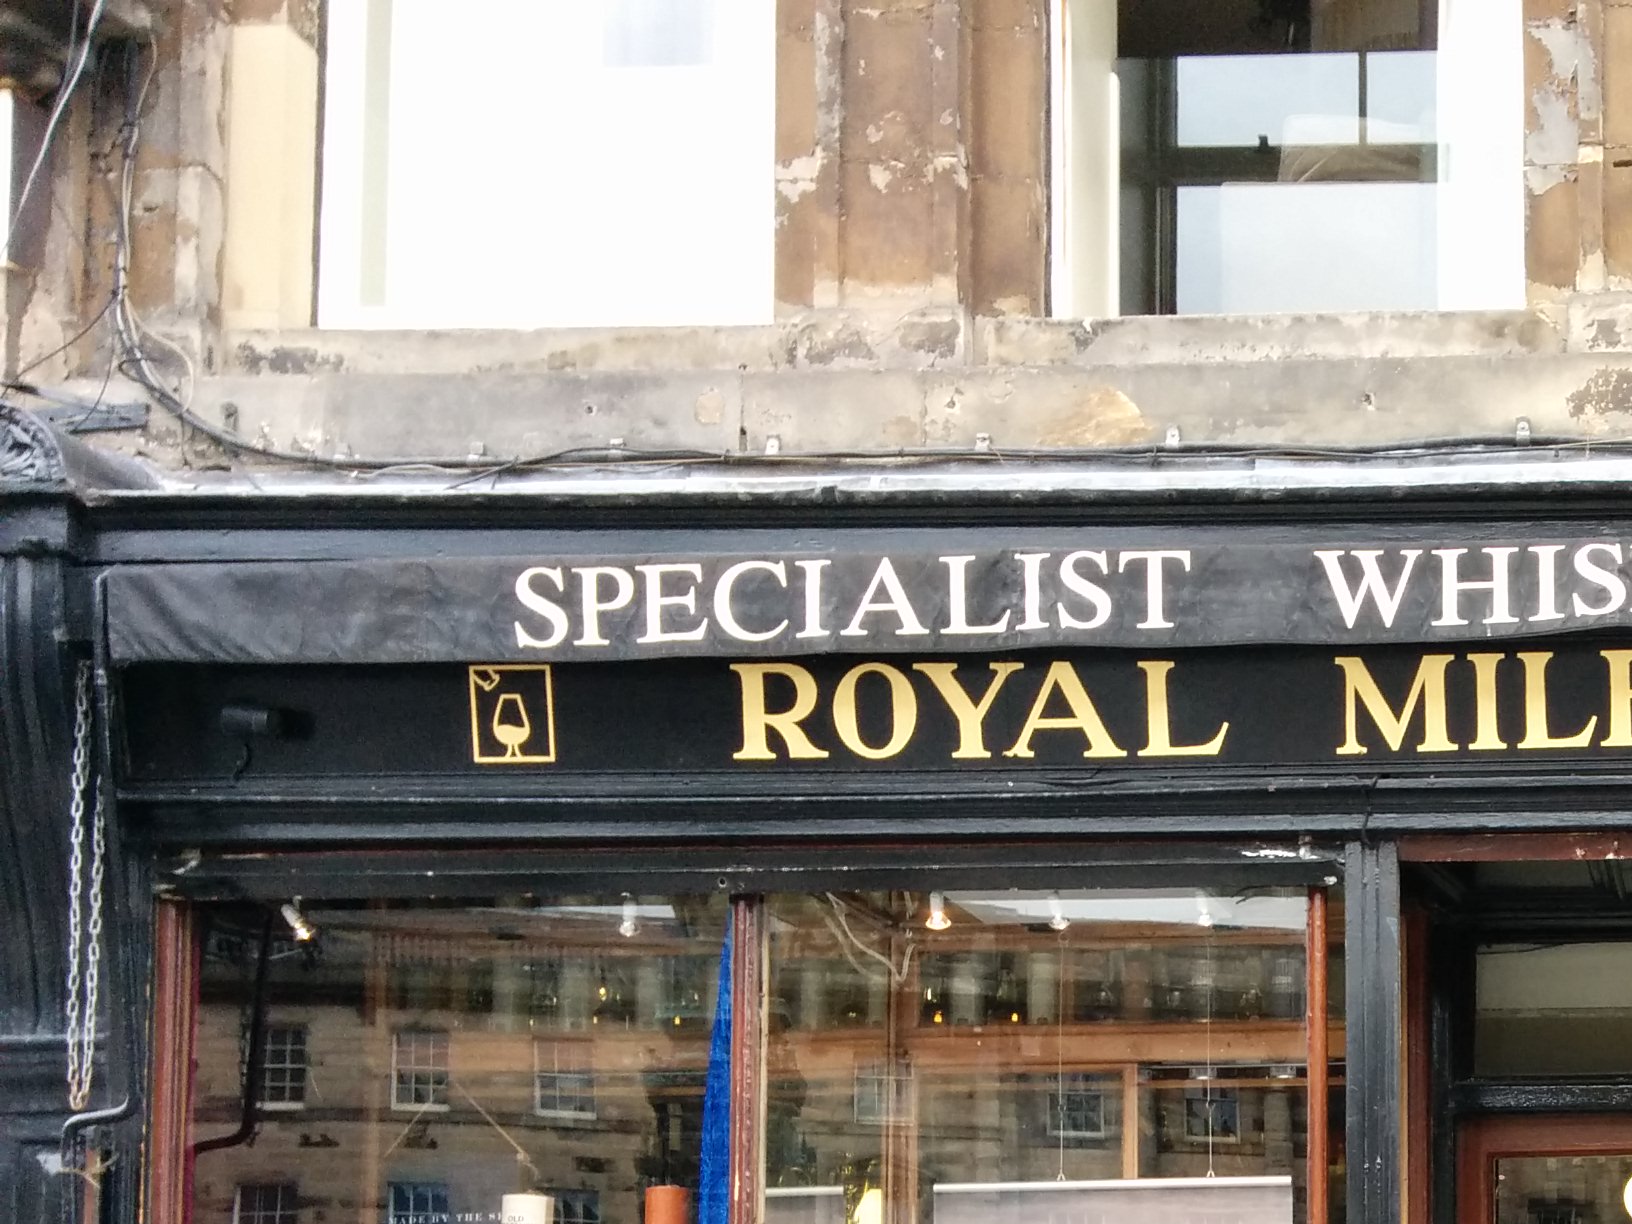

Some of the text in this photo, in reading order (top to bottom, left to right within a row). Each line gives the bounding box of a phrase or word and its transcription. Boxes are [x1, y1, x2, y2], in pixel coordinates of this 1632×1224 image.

[514, 550, 1191, 647] SPECIALIST
[730, 659, 1228, 760] ROYAL
[388, 1214, 426, 1224] MADE
[432, 1213, 449, 1224] BY
[456, 1212, 482, 1222] THE
